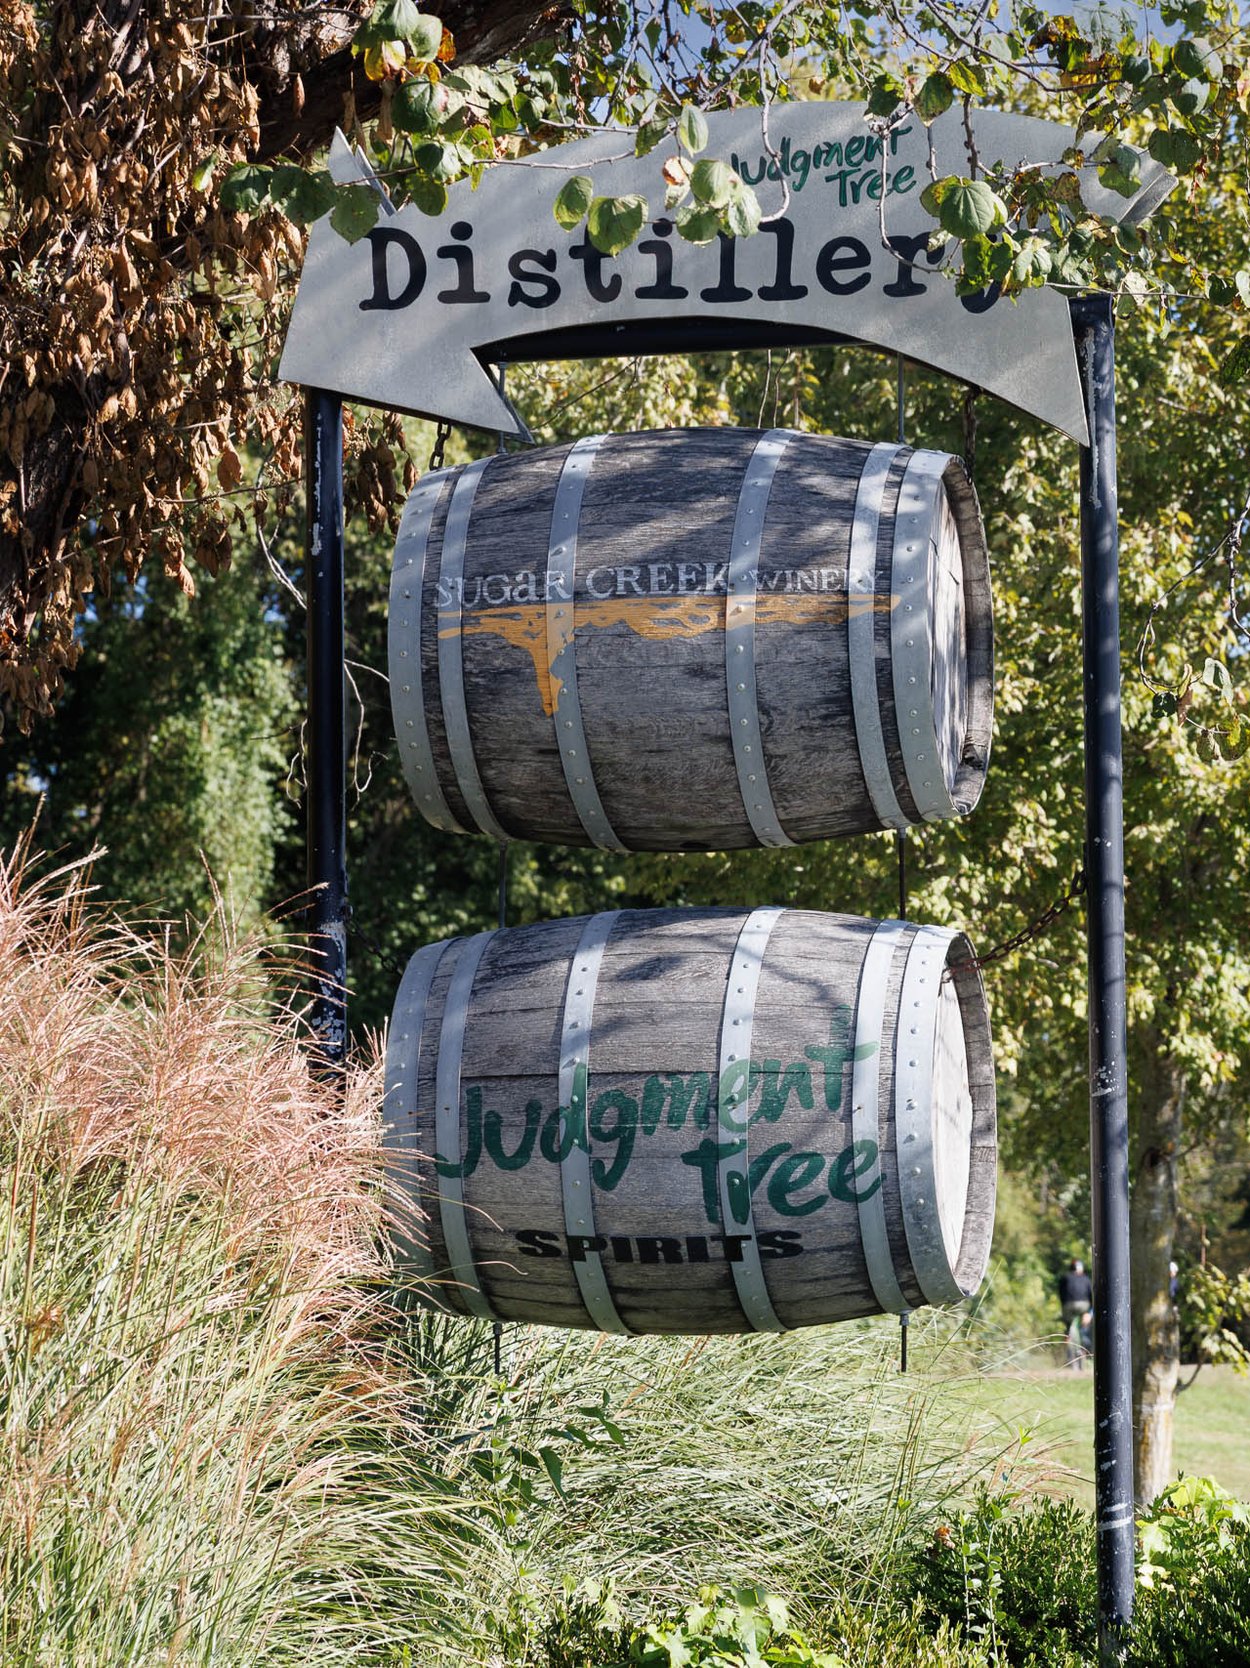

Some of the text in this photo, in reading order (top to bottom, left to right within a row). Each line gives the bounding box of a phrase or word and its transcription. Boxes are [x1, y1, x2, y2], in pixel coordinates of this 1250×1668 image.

[359, 216, 1000, 314] Distiller
[586, 561, 735, 599] CREEK
[749, 568, 884, 592] WINERY
[433, 1004, 879, 1191] Judgment
[514, 1228, 804, 1263] SPIRITS
